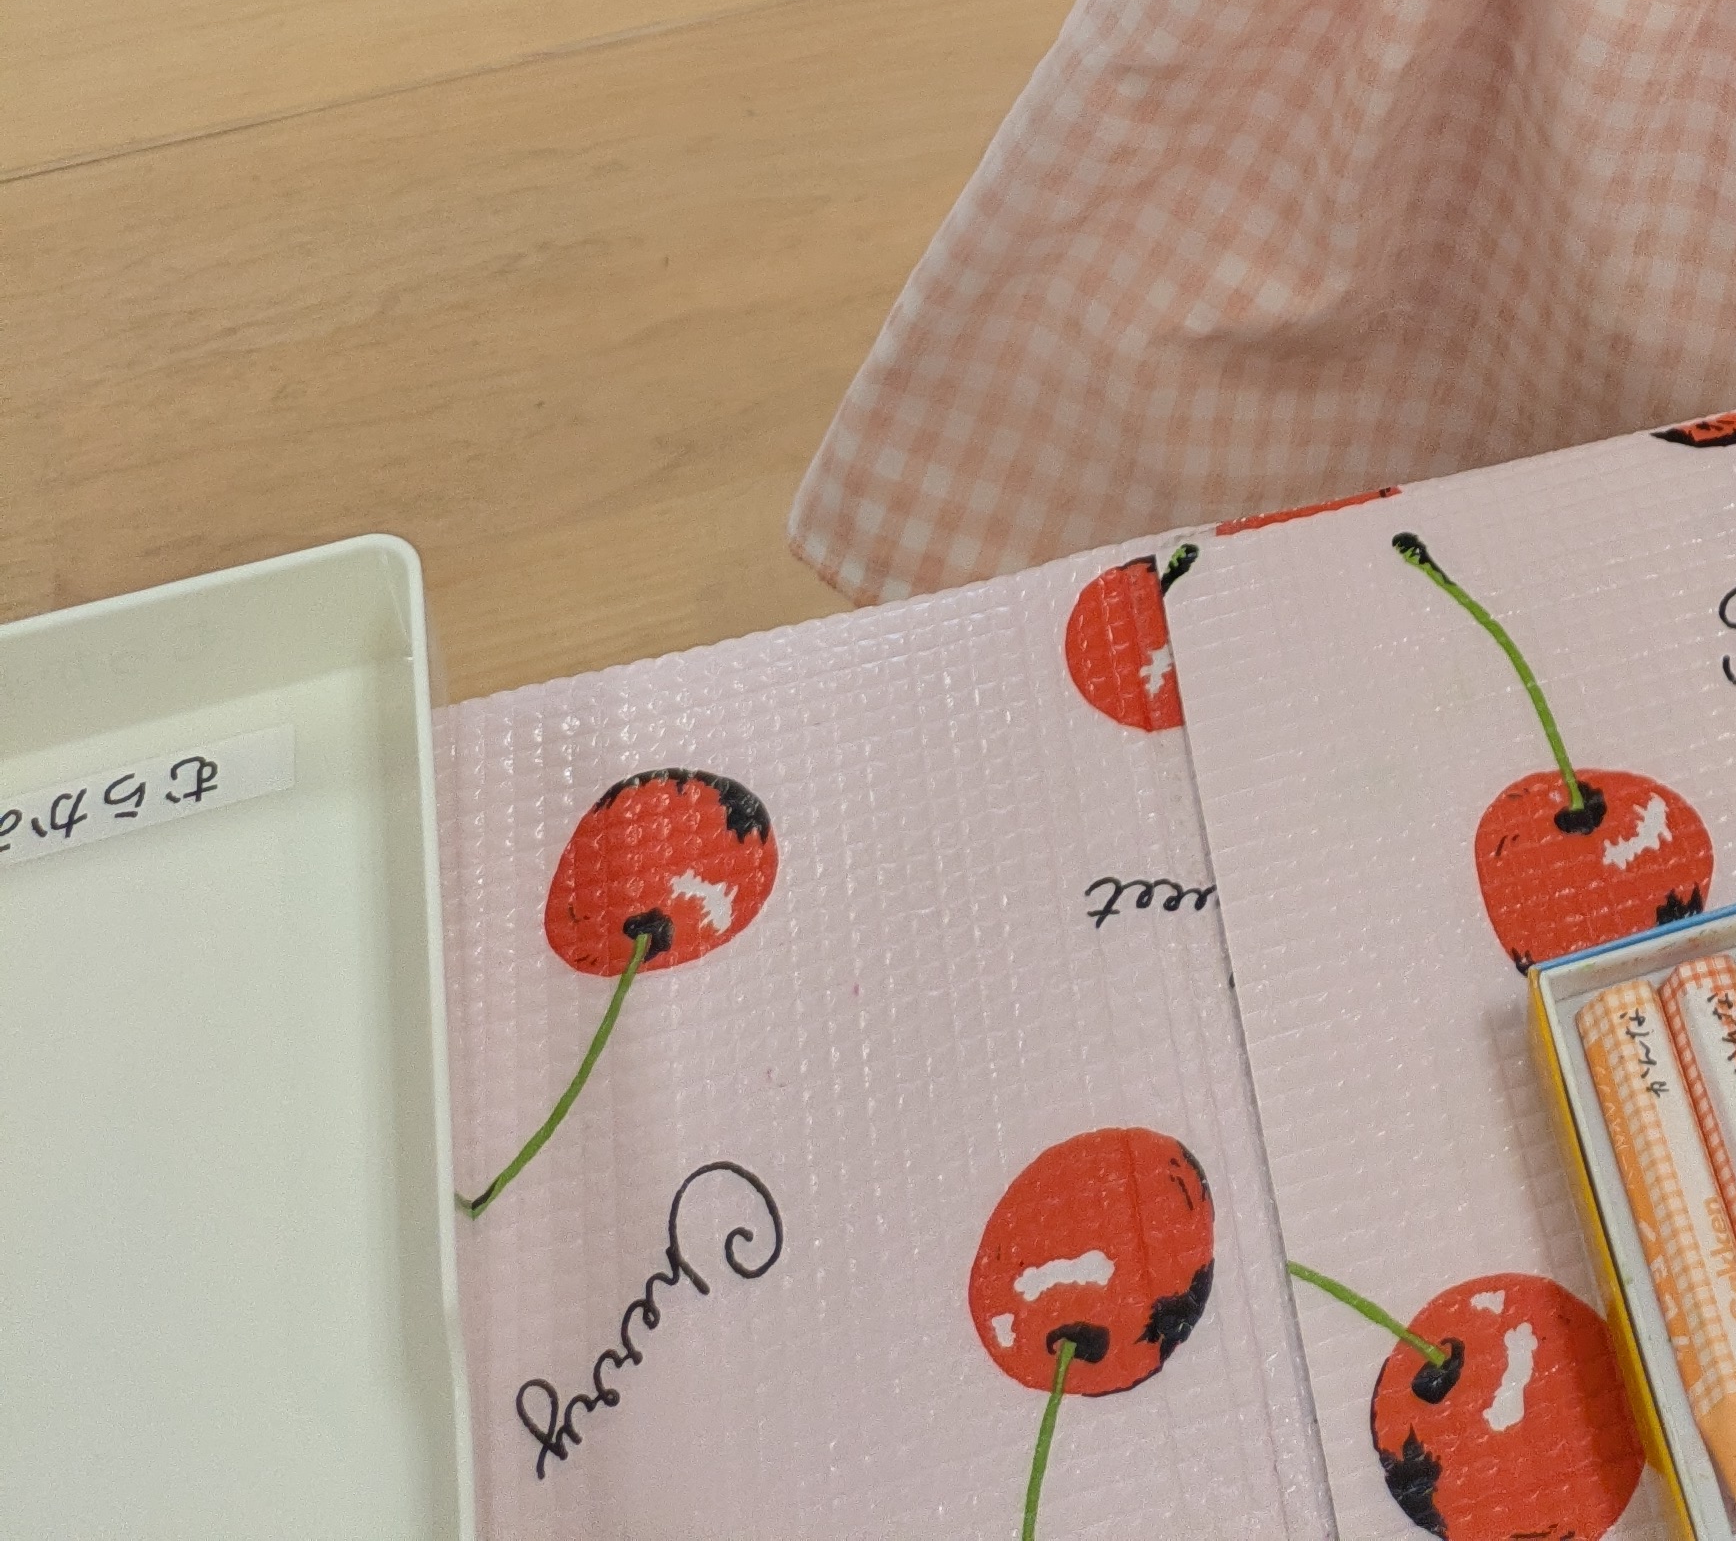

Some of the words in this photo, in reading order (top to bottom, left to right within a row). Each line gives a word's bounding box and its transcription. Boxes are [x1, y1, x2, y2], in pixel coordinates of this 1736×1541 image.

[1620, 1006, 1670, 1101] かんな
[516, 1161, 783, 1480] Cherry
